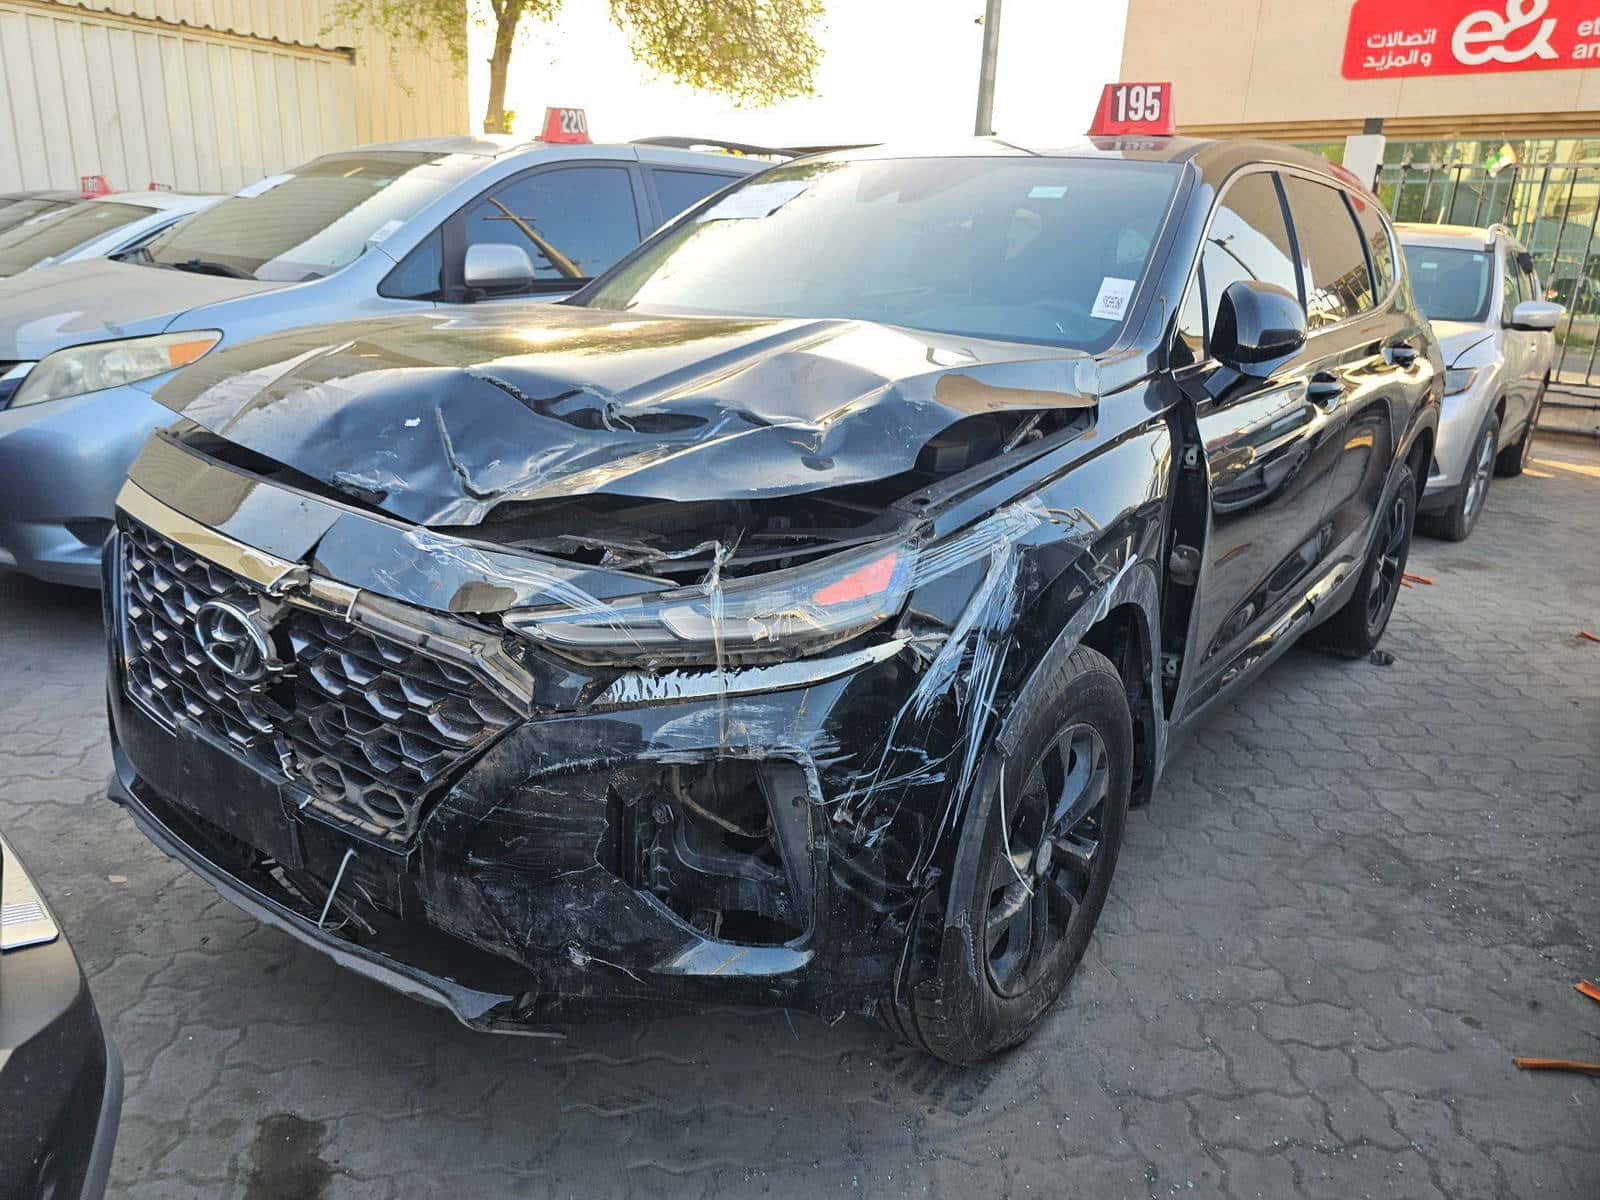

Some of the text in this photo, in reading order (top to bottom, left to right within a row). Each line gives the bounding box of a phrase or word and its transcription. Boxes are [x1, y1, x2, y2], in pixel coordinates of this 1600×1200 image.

[1367, 28, 1437, 48] اتصالات
[1116, 85, 1161, 122] 195
[560, 110, 586, 133] 220
